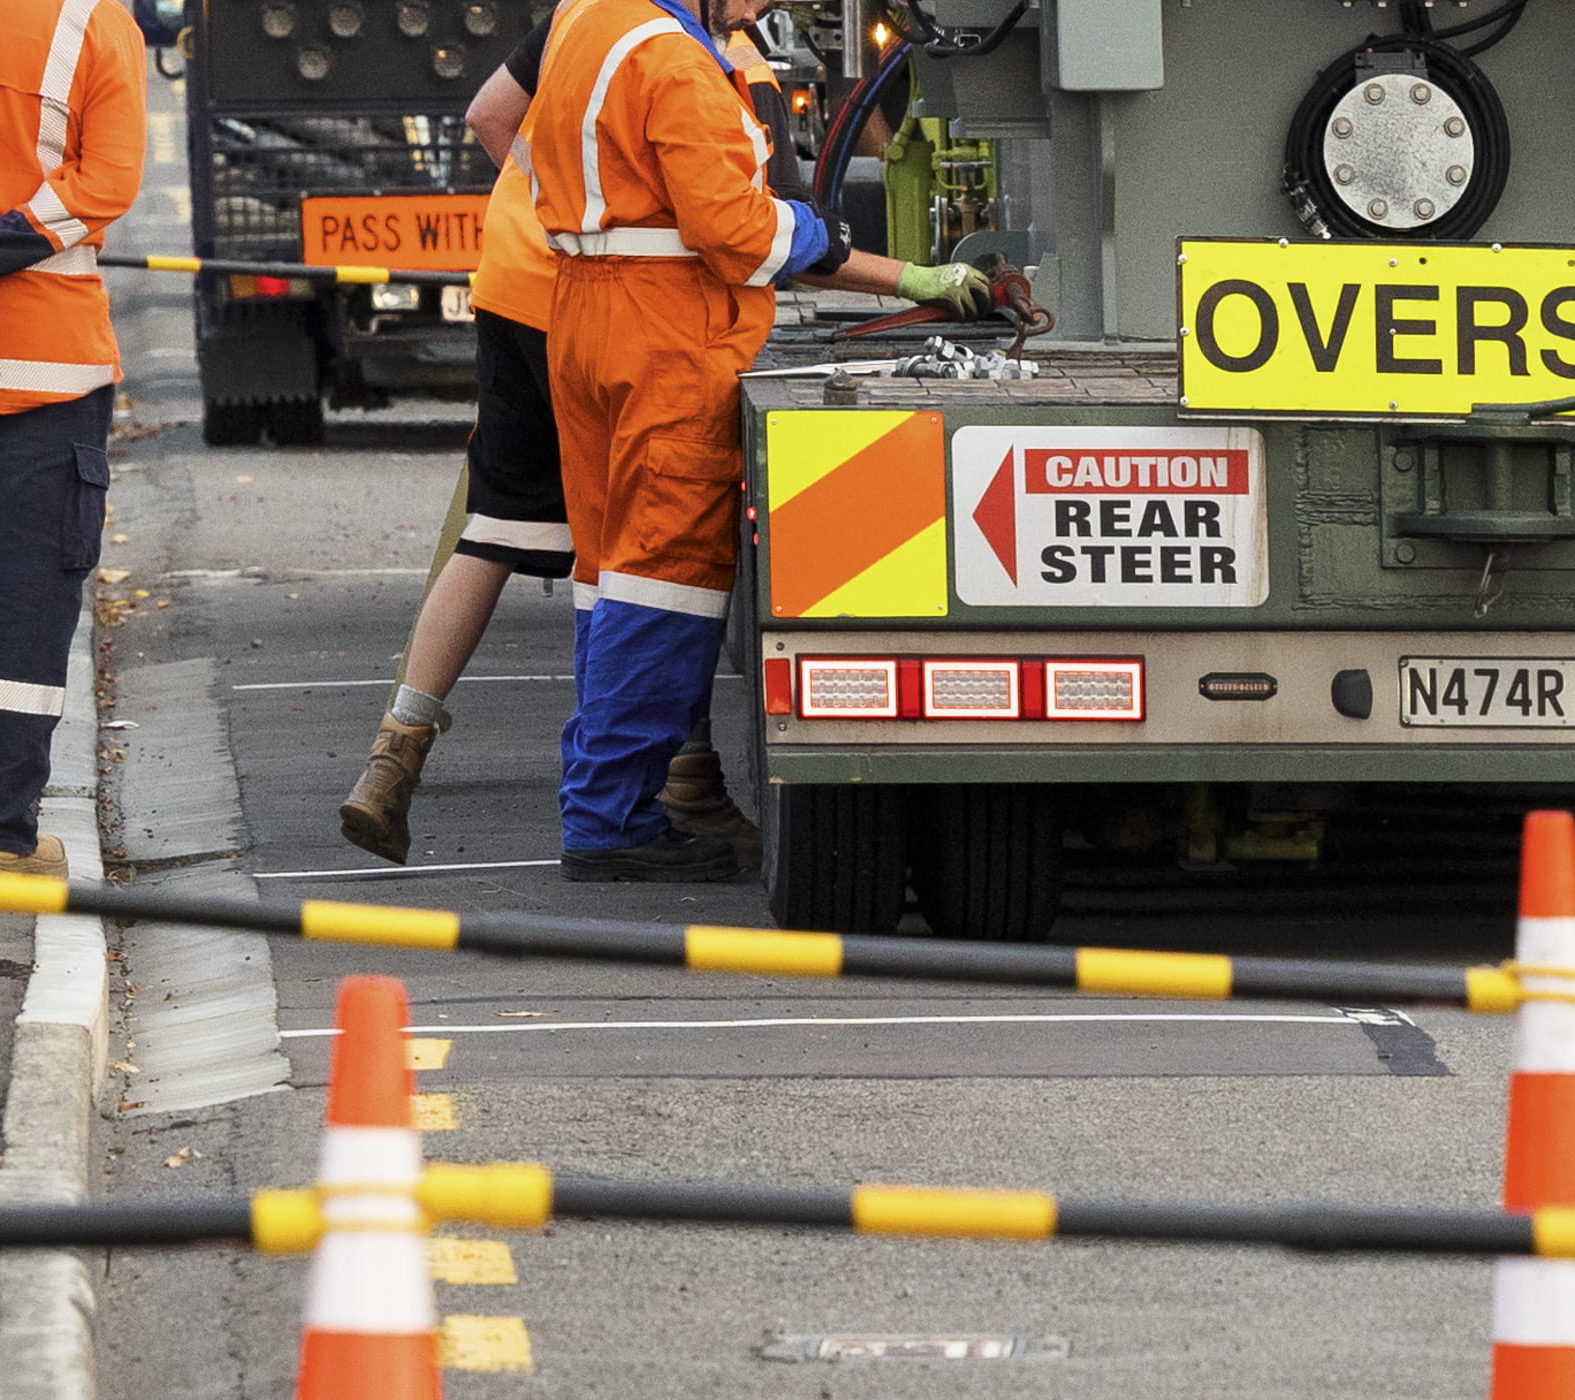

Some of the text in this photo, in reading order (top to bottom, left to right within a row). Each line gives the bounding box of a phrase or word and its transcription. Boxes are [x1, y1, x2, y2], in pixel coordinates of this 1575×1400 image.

[321, 214, 402, 252] PASS
[1045, 455, 1229, 488] CAUTION
[1054, 499, 1223, 538] REAR
[1040, 544, 1238, 584] STEER
[1408, 667, 1566, 718] N474R
